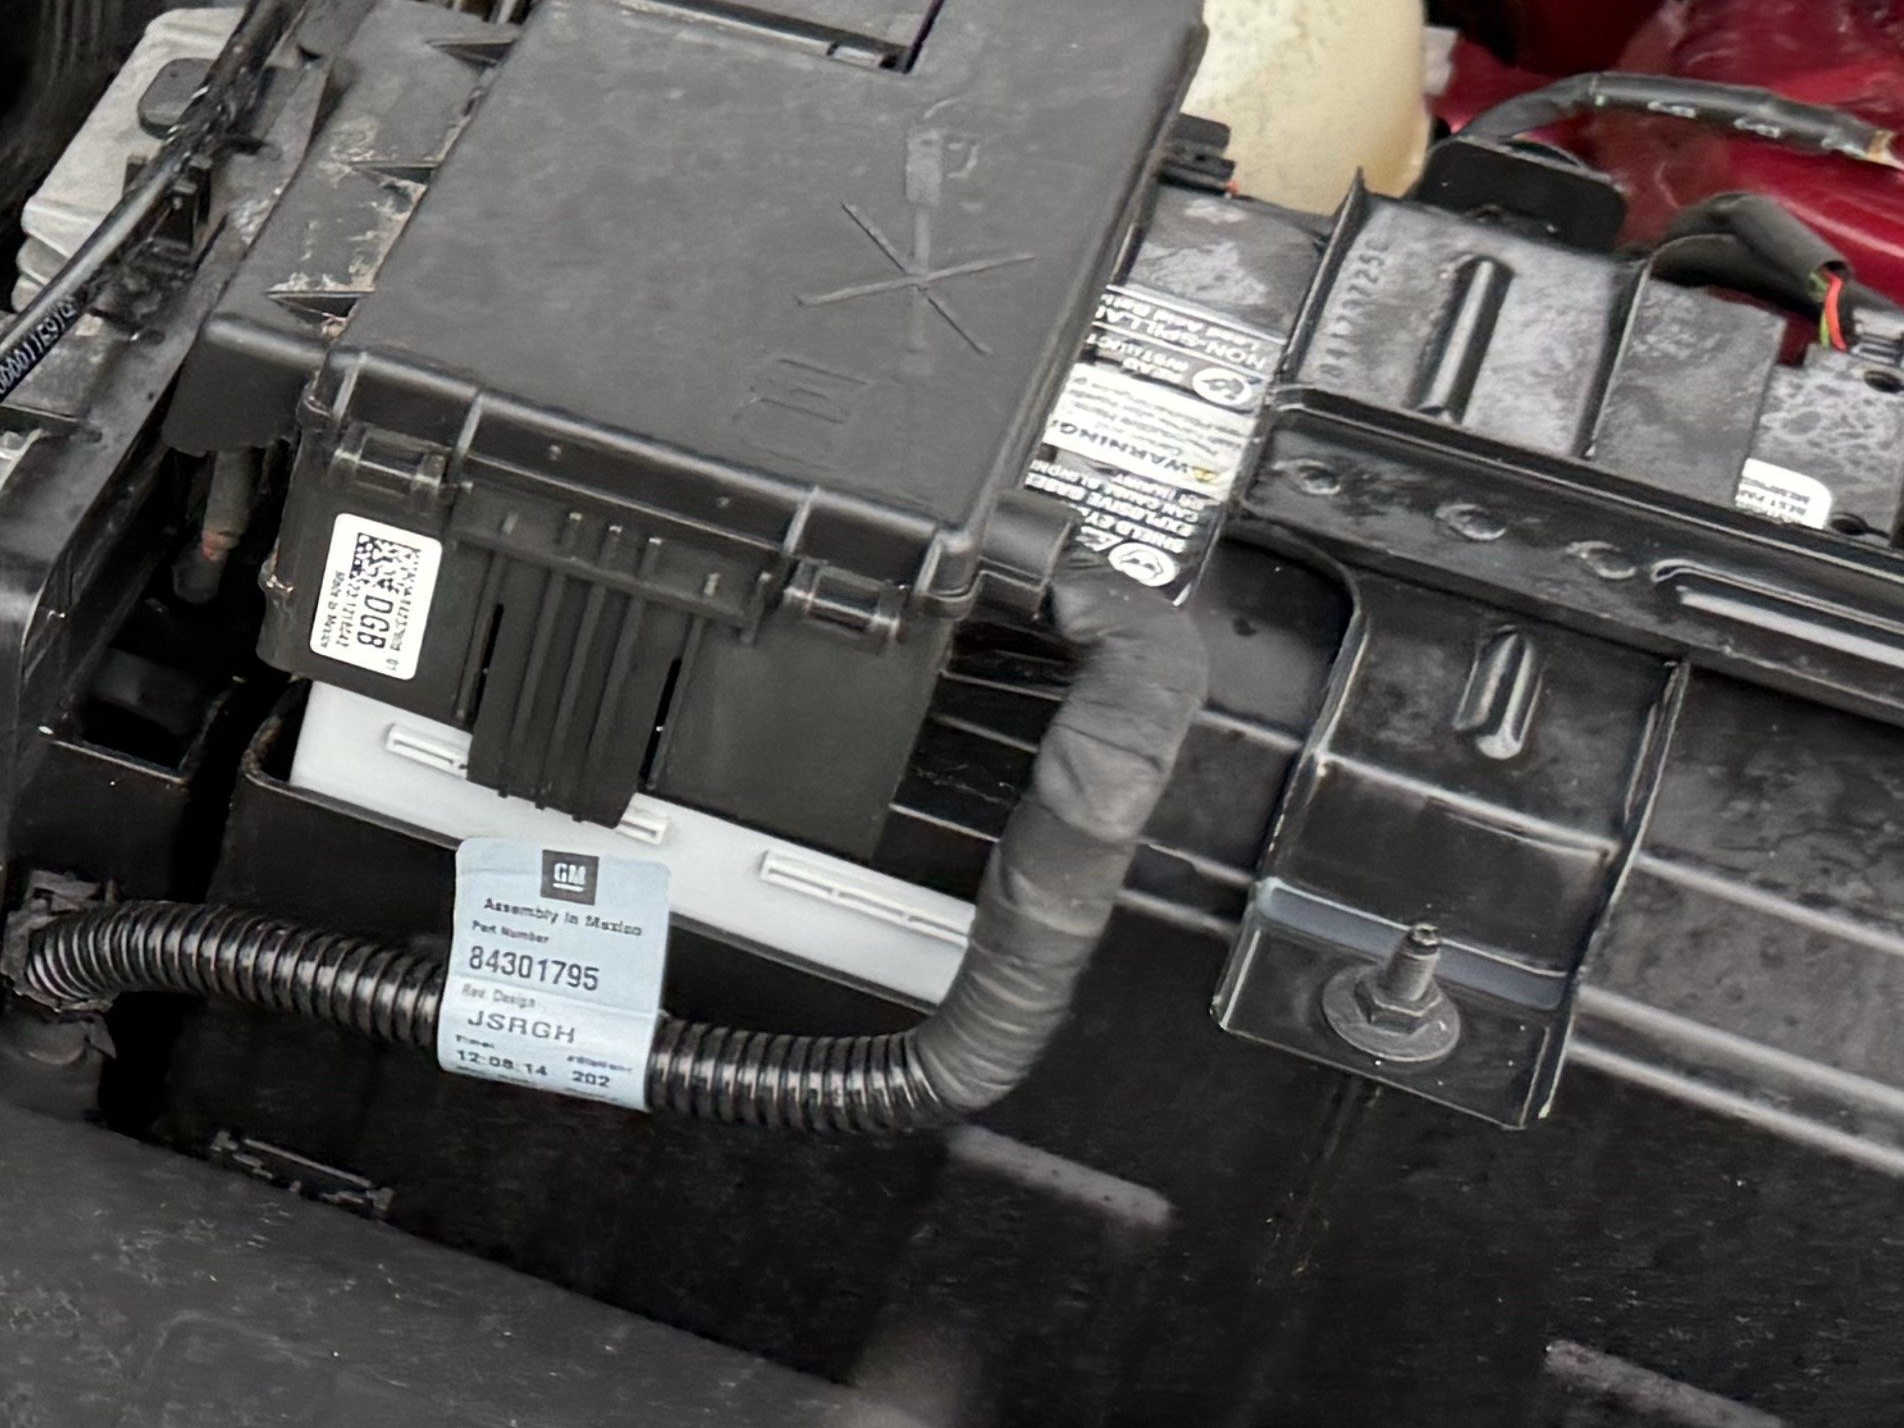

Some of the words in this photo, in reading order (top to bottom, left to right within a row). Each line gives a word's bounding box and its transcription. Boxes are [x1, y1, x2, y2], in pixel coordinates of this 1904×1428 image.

[1151, 307, 1202, 332] Acid
[1204, 325, 1259, 350] Lead
[1121, 357, 1185, 383] READ
[1085, 494, 1198, 536] EXPLOSIVE
[1161, 503, 1200, 522] CAN
[1120, 525, 1187, 554] SHIELD
[357, 594, 393, 650] DGB
[553, 862, 587, 886] GM
[483, 897, 560, 924] Assembly
[585, 915, 643, 937] Mexico
[471, 920, 497, 934] Part
[500, 925, 550, 944] Number
[469, 946, 600, 992] 84301795
[467, 1010, 576, 1044] JSRGH
[571, 1070, 611, 1089] 202
